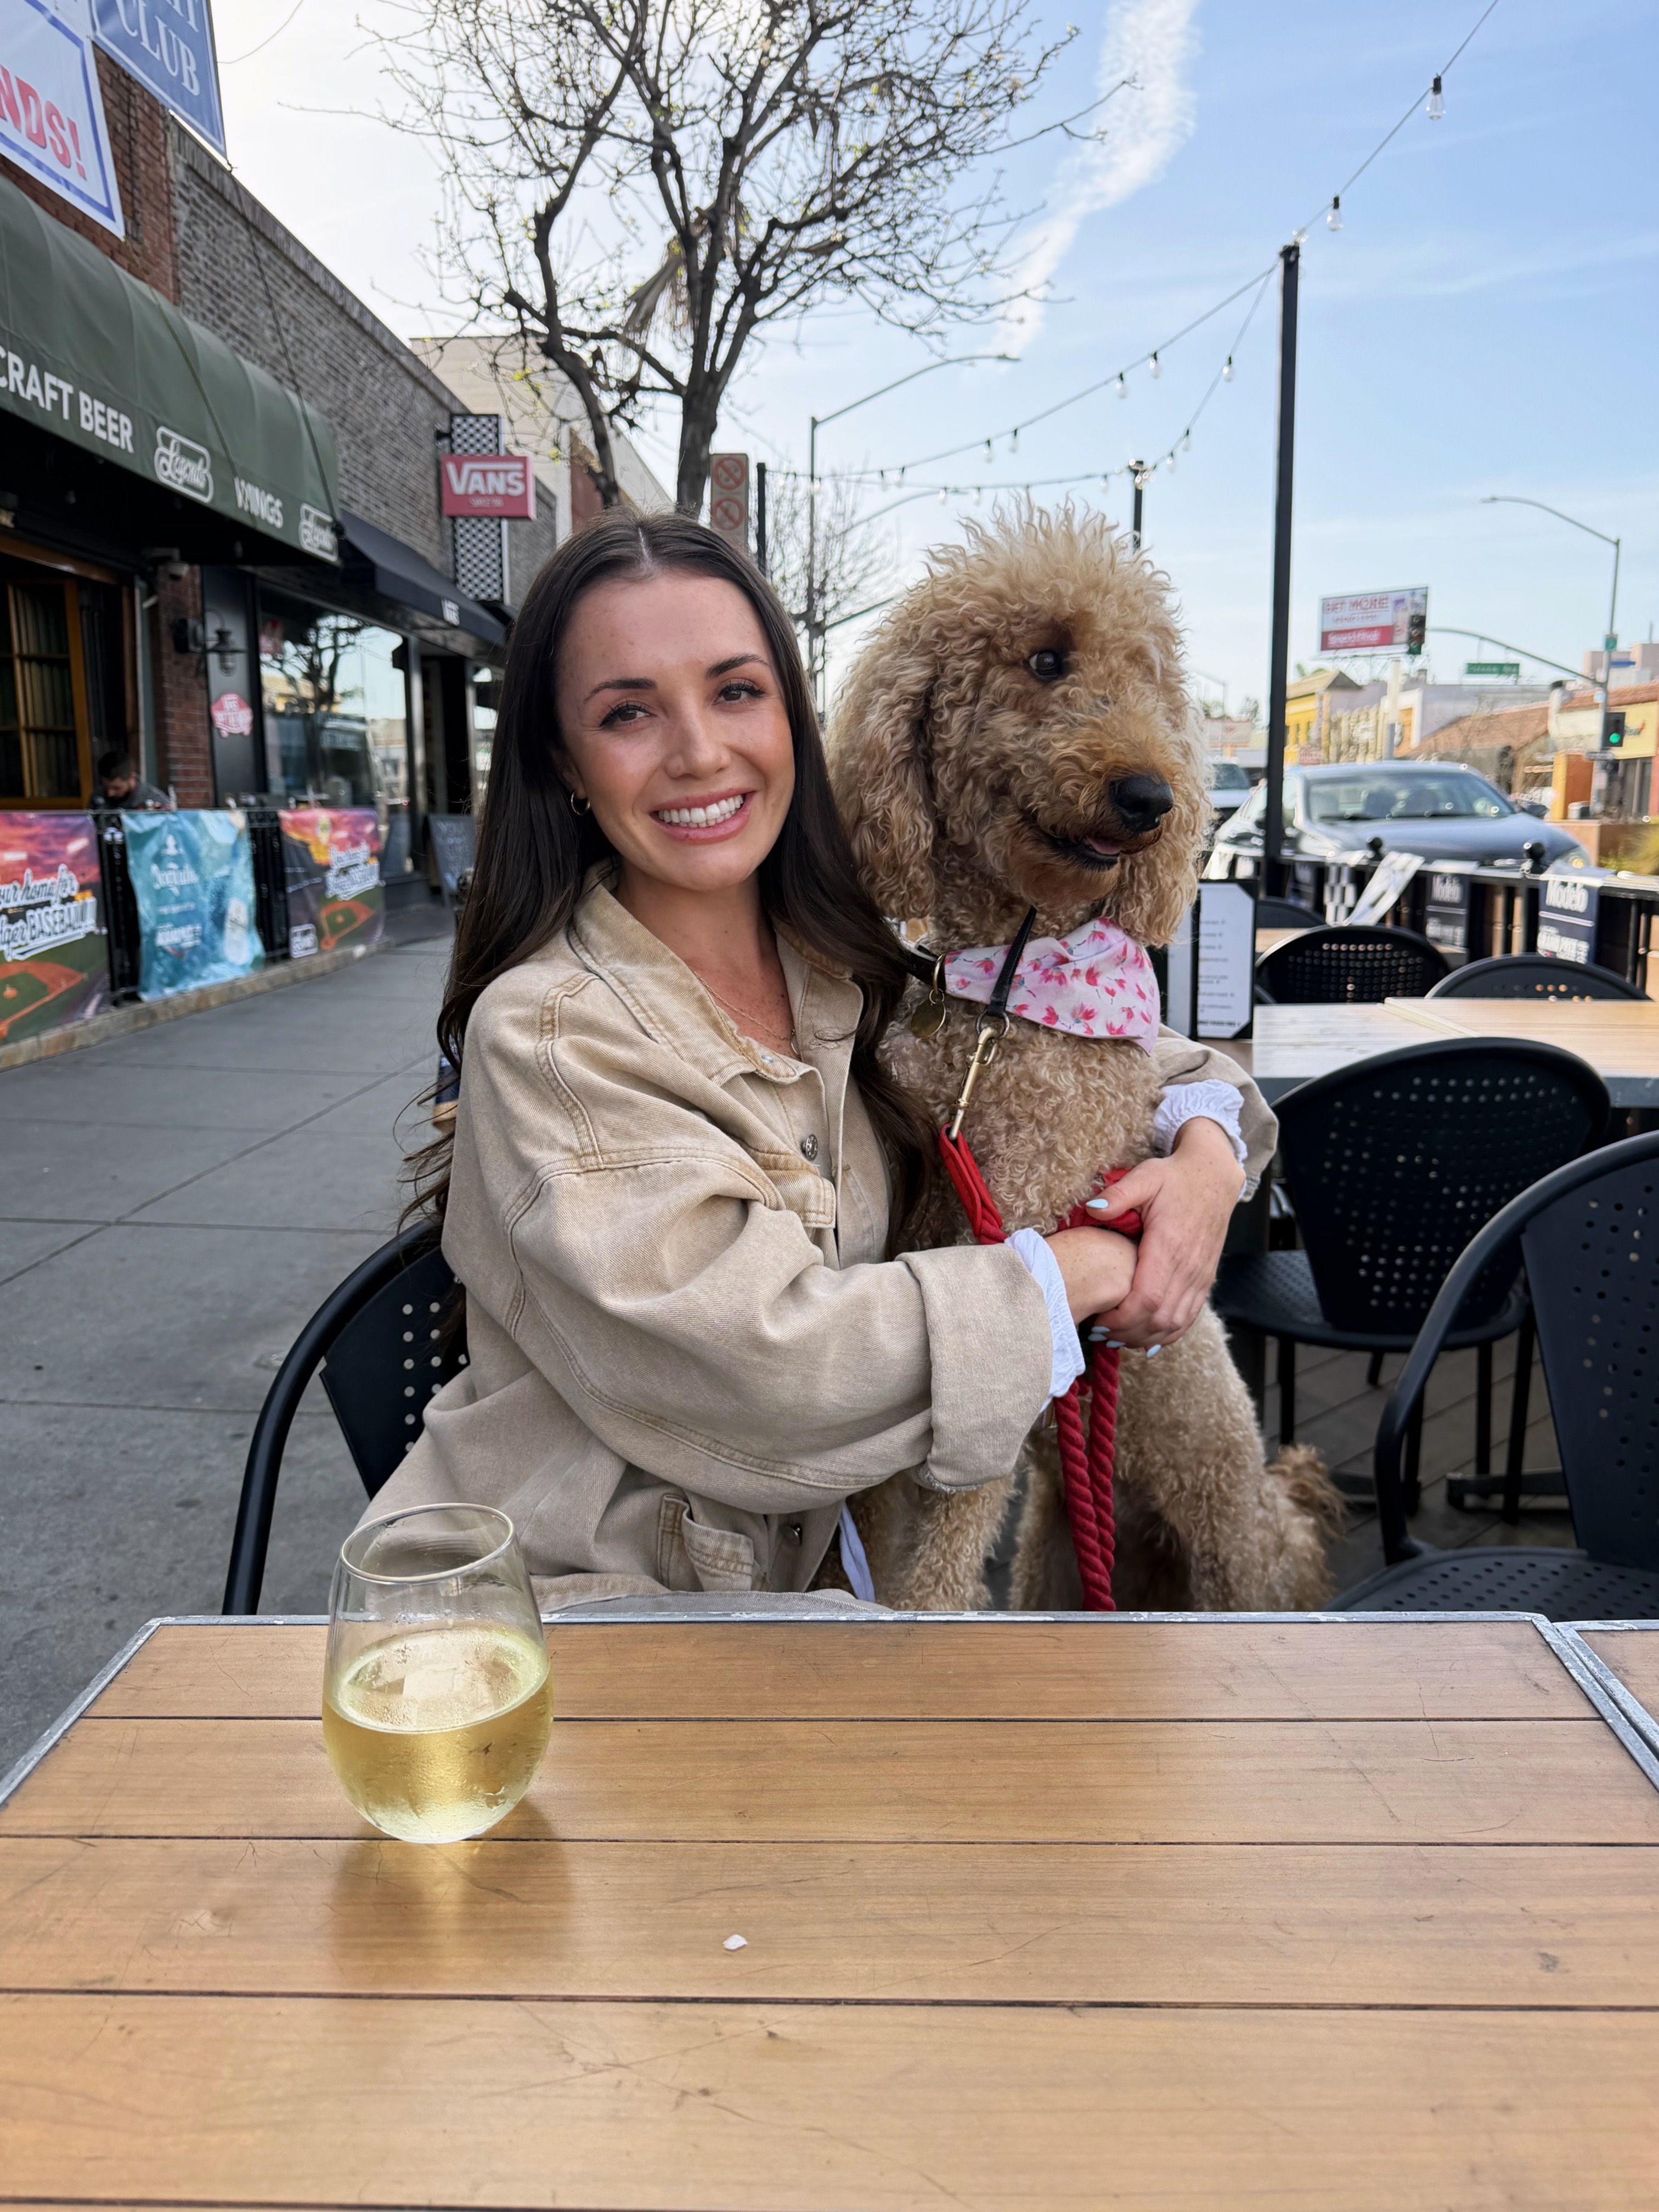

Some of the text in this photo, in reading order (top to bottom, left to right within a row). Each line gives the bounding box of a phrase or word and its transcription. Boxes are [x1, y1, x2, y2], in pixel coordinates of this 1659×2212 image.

[116, 0, 200, 96] CLUB
[78, 390, 134, 454] BEER
[445, 461, 526, 497] VANS
[234, 476, 284, 529] WINGS
[21, 870, 55, 901] home
[1431, 873, 1464, 904] Modelo
[1545, 879, 1589, 913] Modelo
